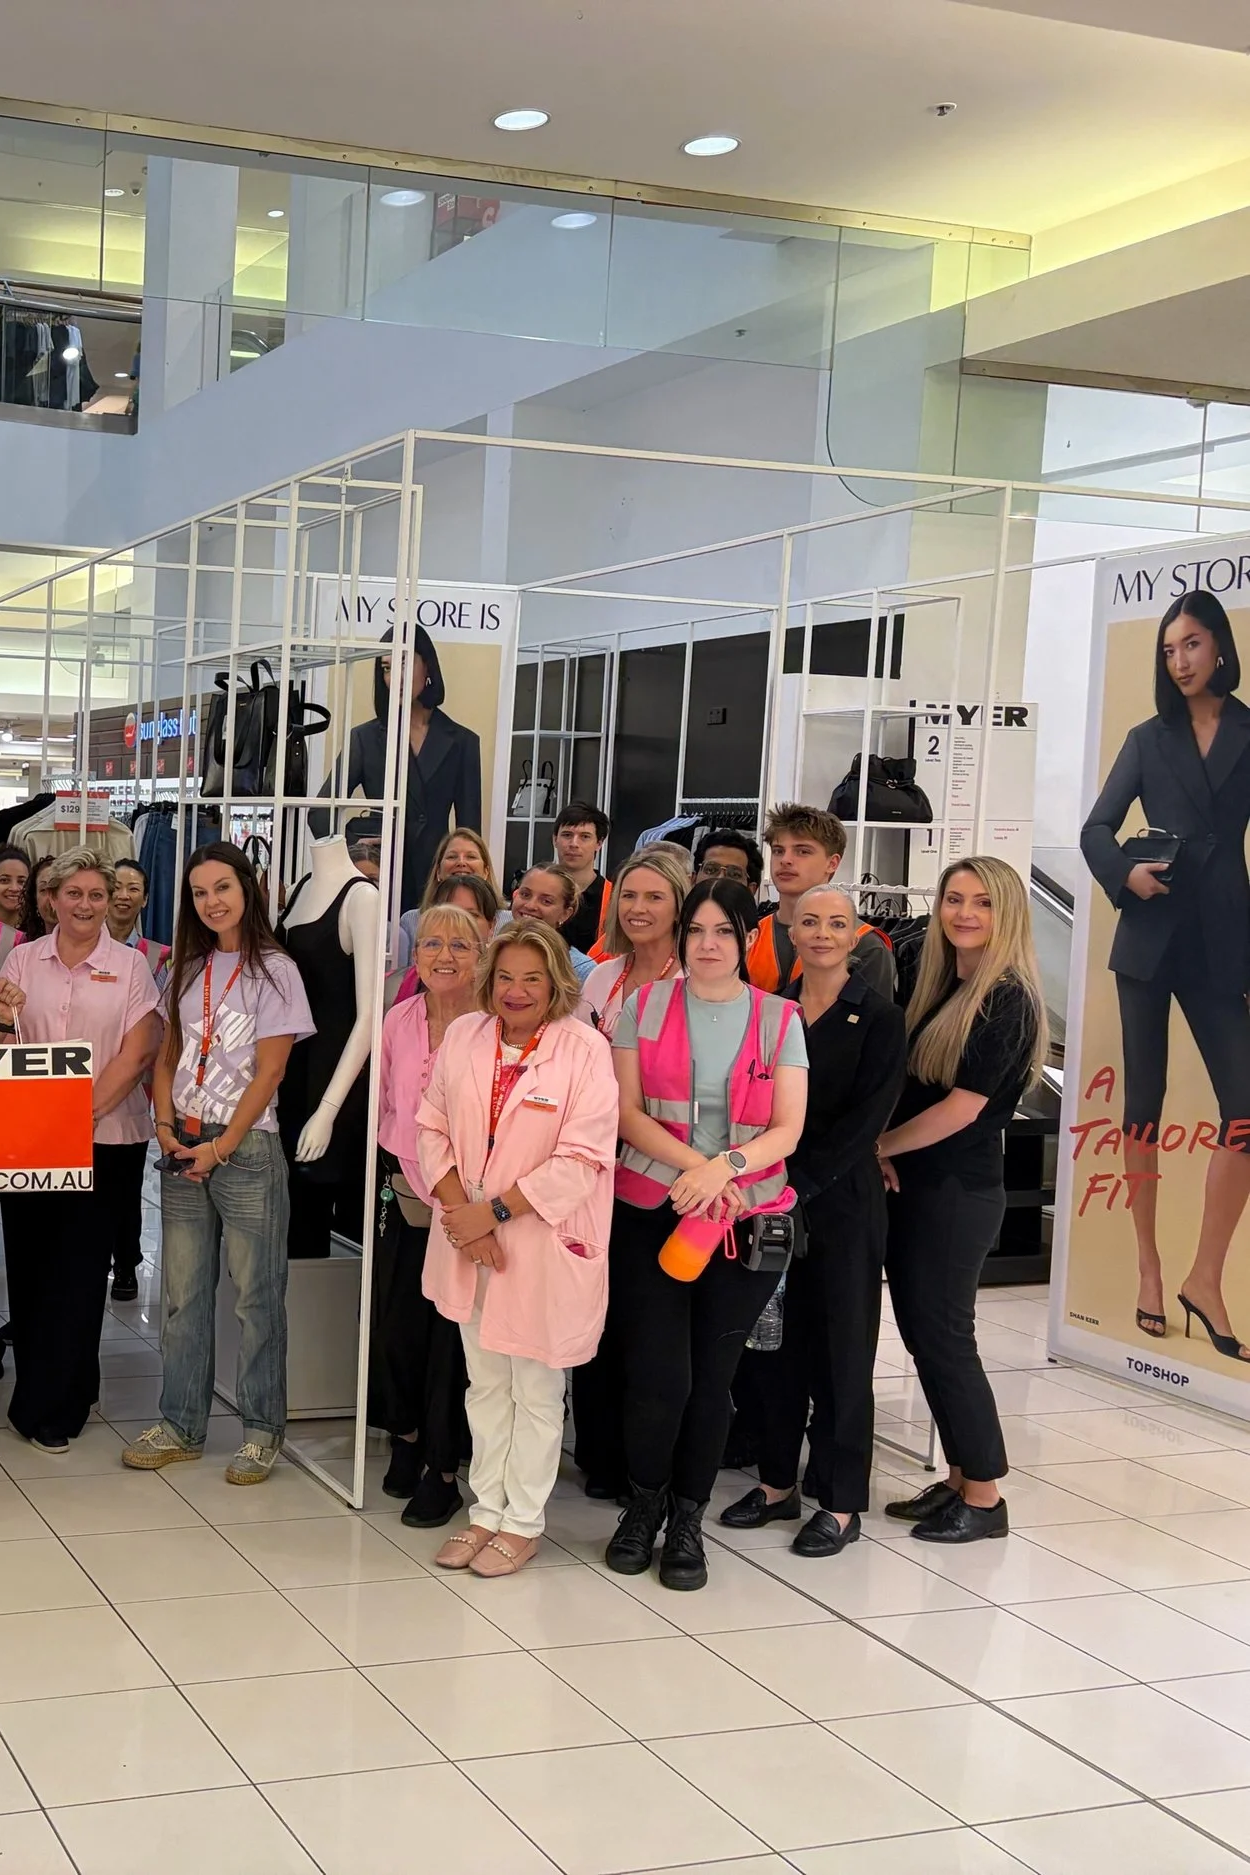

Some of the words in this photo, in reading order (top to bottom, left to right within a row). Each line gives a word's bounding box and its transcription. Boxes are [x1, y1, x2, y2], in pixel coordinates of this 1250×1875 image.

[1113, 567, 1164, 605] MY
[386, 597, 472, 629] SORE
[480, 603, 500, 631] IS
[928, 735, 939, 755] 2
[1085, 1066, 1115, 1103] A
[1079, 1173, 1162, 1217] FIT
[1126, 1357, 1190, 1387] TOPSHOP
